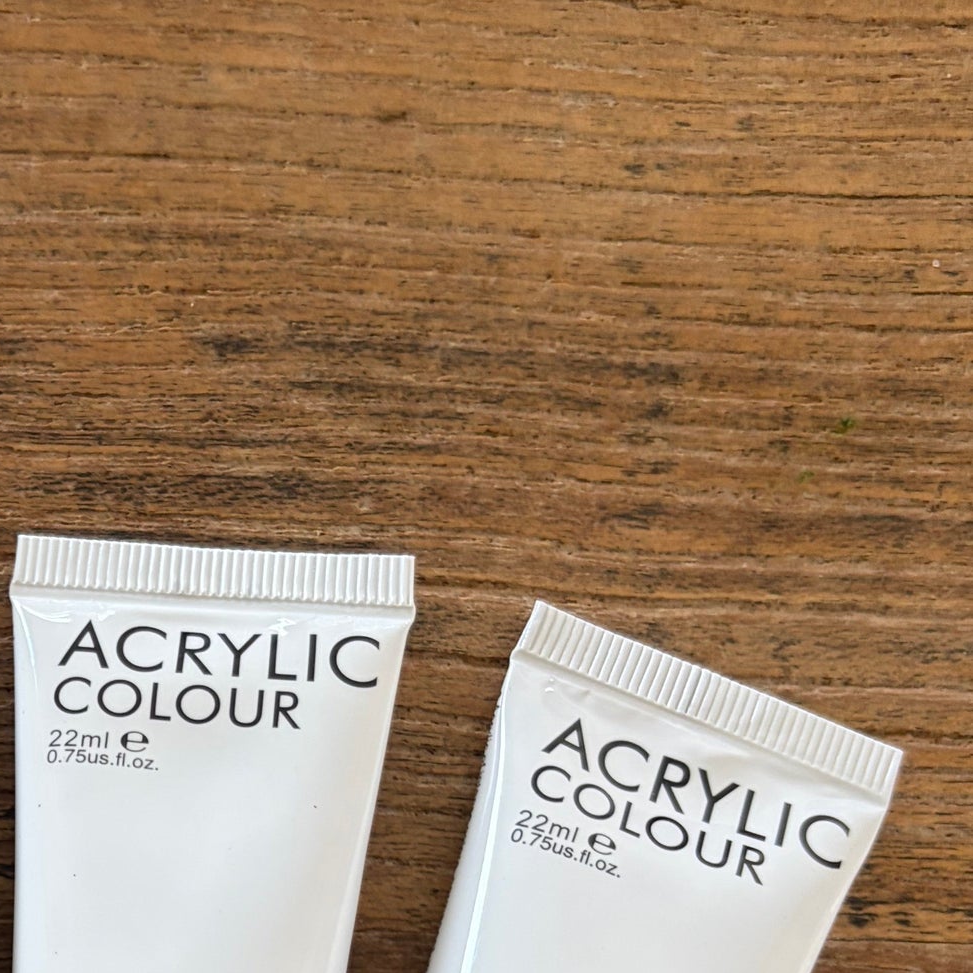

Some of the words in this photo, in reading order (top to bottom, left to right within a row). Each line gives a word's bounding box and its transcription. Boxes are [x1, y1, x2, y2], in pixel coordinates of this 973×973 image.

[58, 619, 381, 689] ACRYLIC
[53, 676, 301, 730] COLOUR
[46, 749, 159, 771] 0.75us.fl.oz.
[48, 729, 109, 749] 22ml
[541, 717, 851, 869] ACRYLIC
[515, 809, 579, 843] 22ml
[530, 765, 764, 887] COLOUR
[510, 828, 621, 879] 0.75us.fl.oz.
